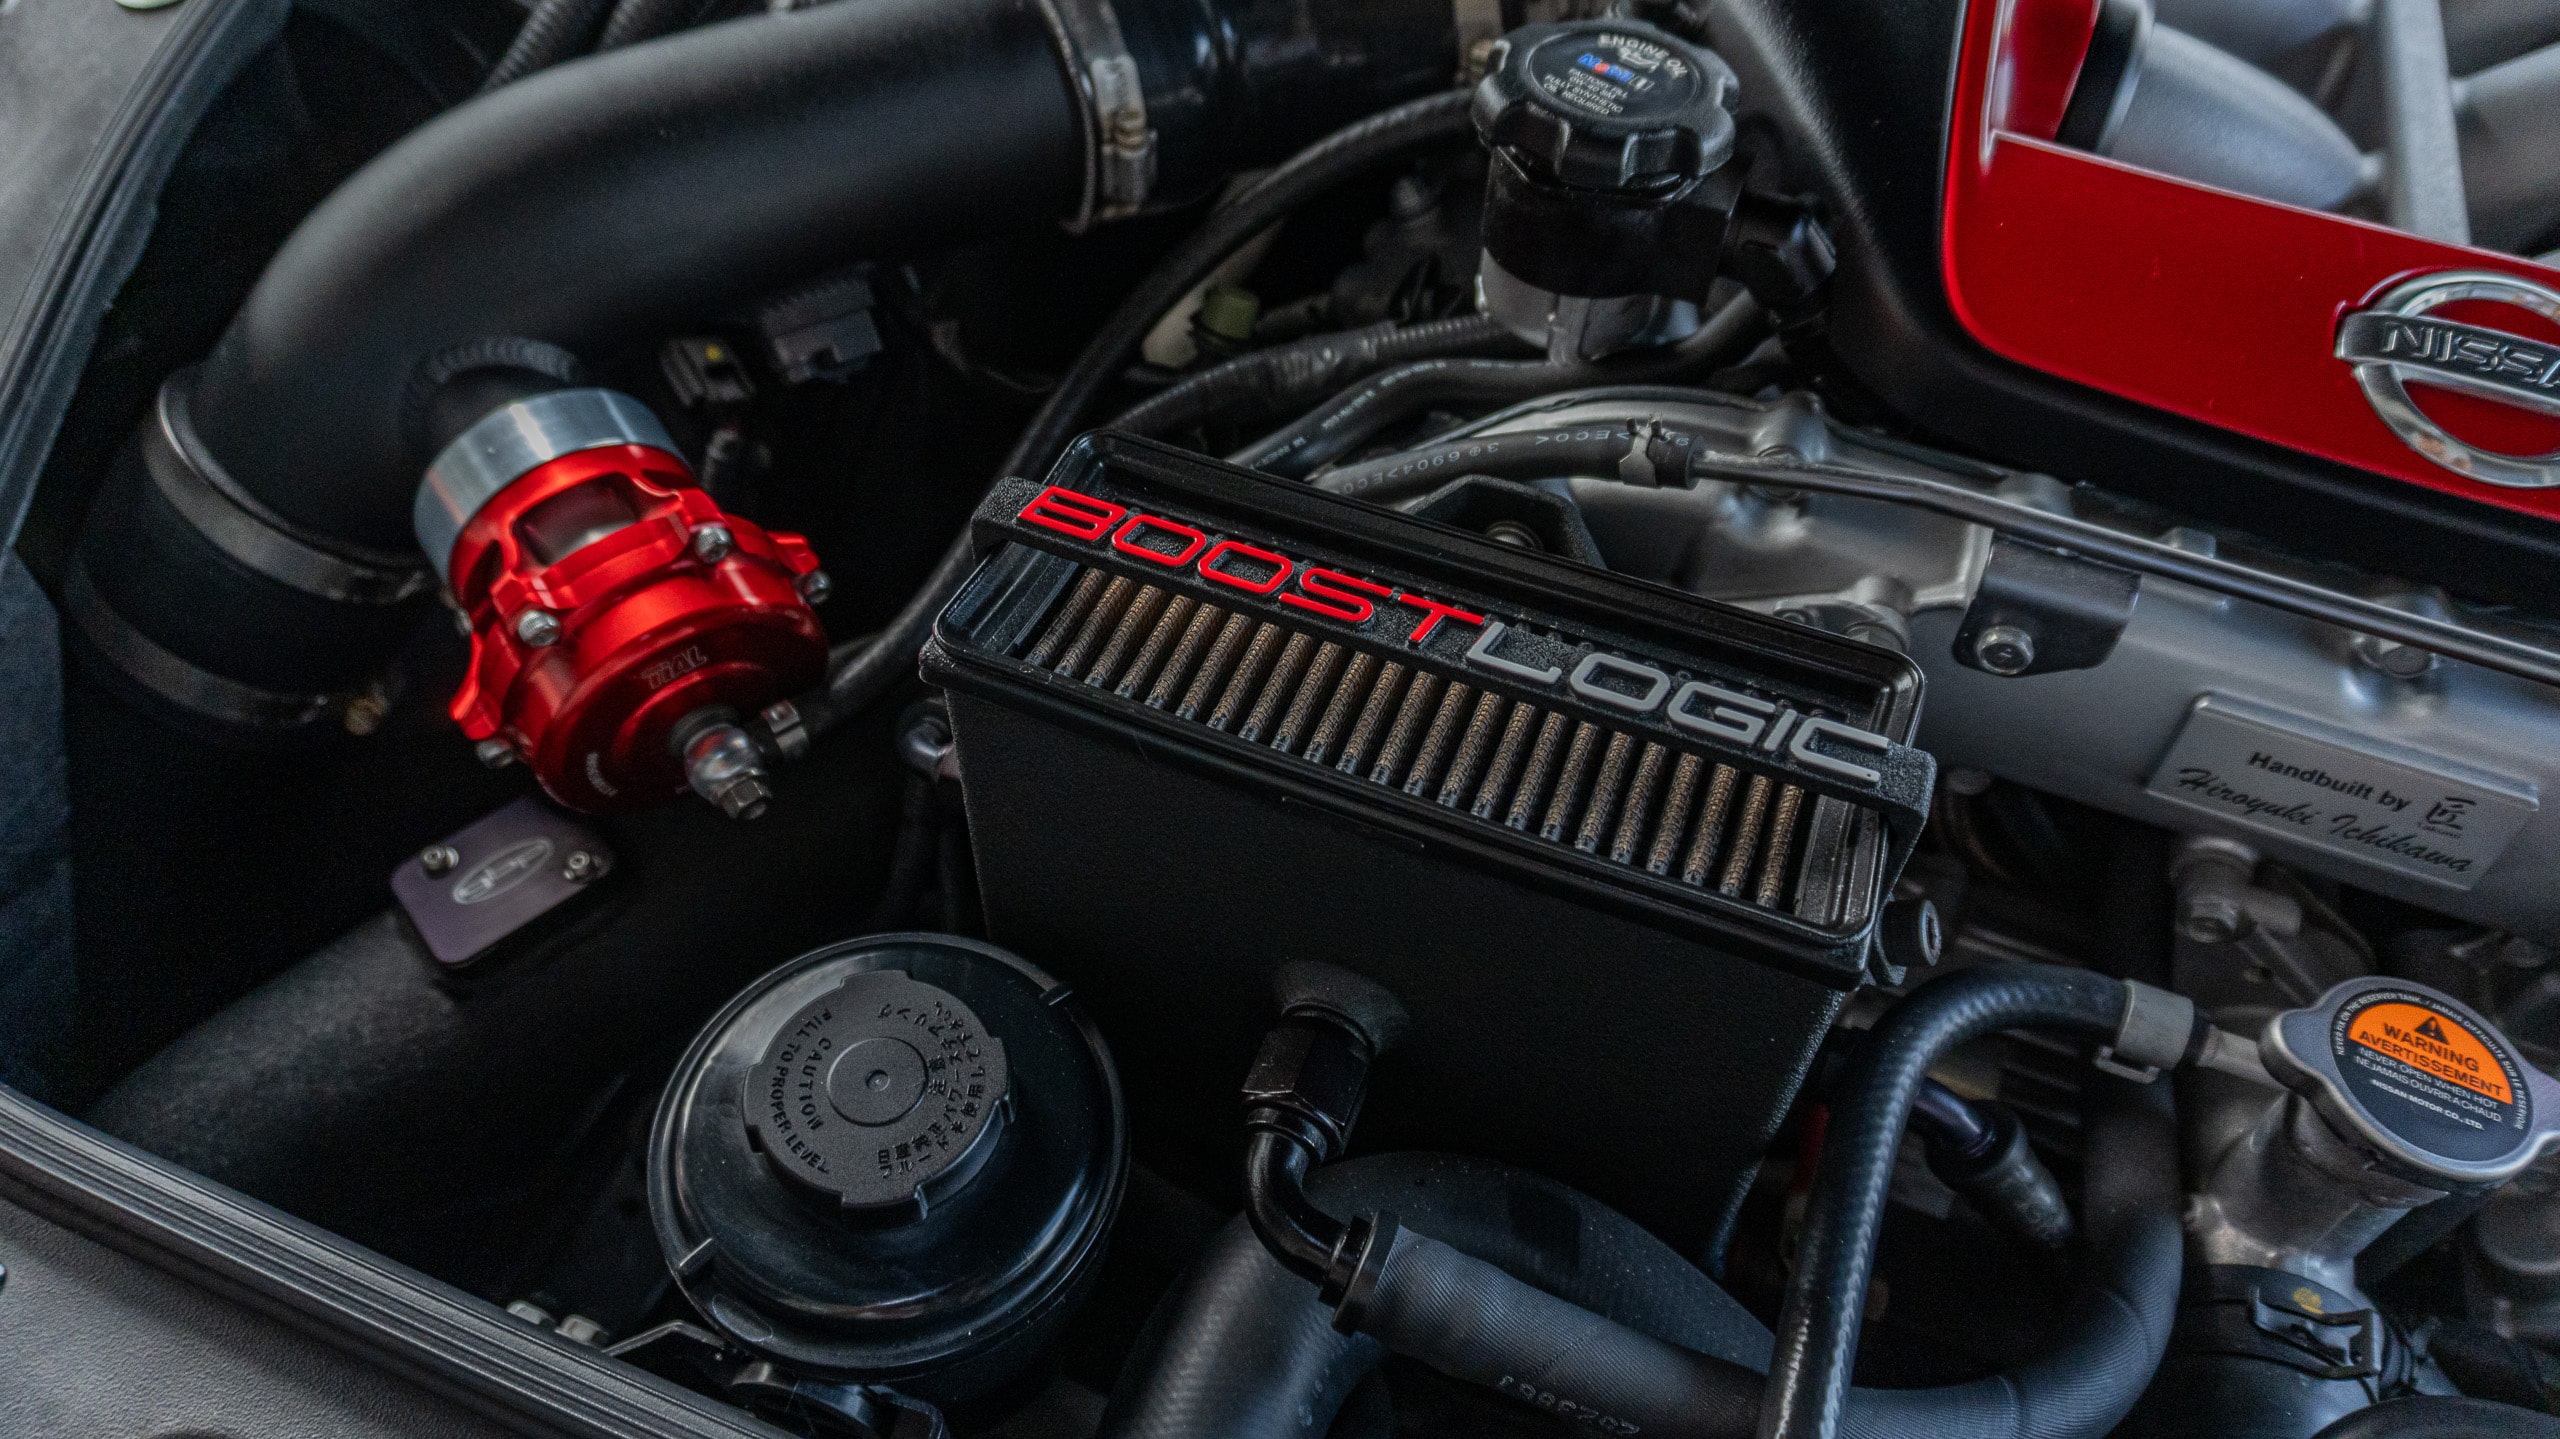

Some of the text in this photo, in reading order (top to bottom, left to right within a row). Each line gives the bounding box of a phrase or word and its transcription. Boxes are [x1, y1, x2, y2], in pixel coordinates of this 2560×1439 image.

[1598, 34, 1688, 79] ENGINE OIL
[1543, 83, 1610, 115] OIL REQUIRED
[1544, 74, 1624, 113] FULLY SYNTHETIC
[1609, 86, 1629, 99] FILL
[2248, 751, 2375, 799] Handbuilt
[2377, 790, 2412, 812] by
[2178, 767, 2474, 872] Hiroyuki Ichikawa
[2334, 1031, 2346, 1056] NEVER
[2431, 1003, 2463, 1022] JAMAIS
[2383, 1022, 2480, 1073] WARNING
[798, 1037, 832, 1131] CAUTION
[2355, 1056, 2370, 1068] NE
[2370, 1060, 2409, 1084] JAMAIS
[2409, 1079, 2451, 1102] OUVRIR
[2359, 1030, 2504, 1097] AVERTISSEMENT
[2360, 1047, 2397, 1069] NEVER
[2399, 1063, 2432, 1083] OPEN
[2434, 1077, 2471, 1099] WHEN
[770, 1008, 832, 1175] FILL TO PROPER LEVEL
[2370, 1079, 2408, 1099] NISSAN
[2409, 1094, 2443, 1113] MOTOR
